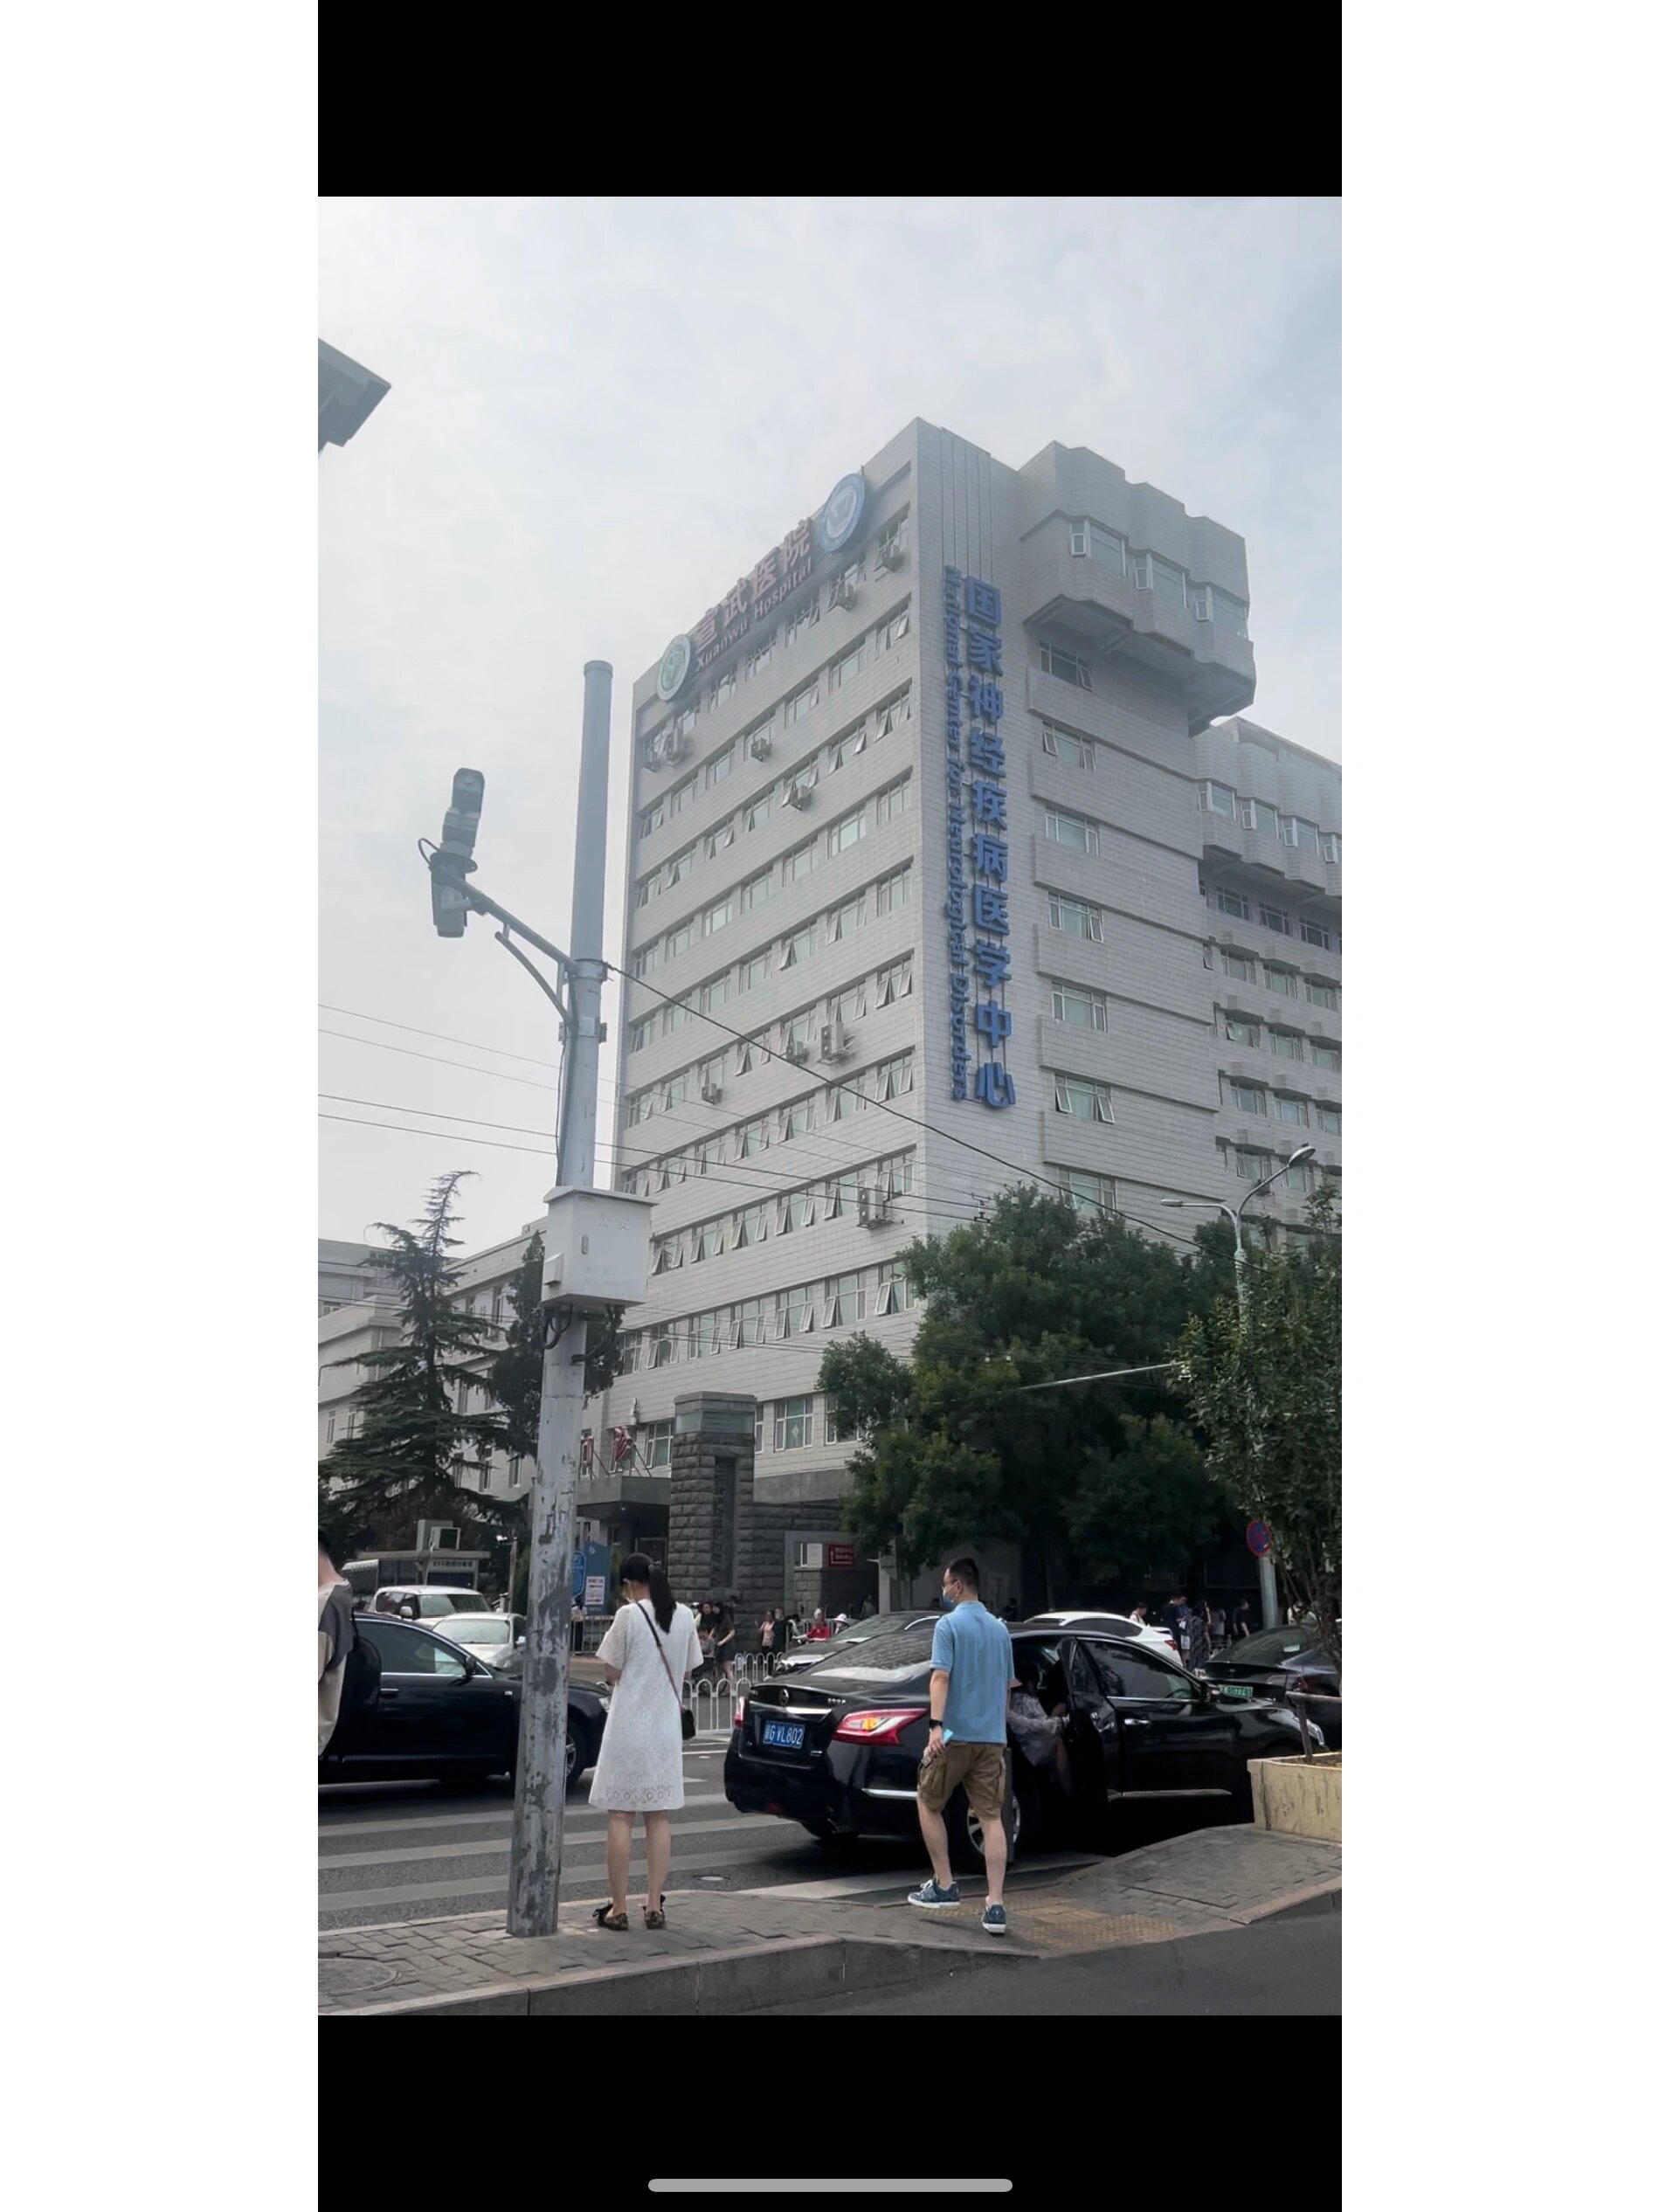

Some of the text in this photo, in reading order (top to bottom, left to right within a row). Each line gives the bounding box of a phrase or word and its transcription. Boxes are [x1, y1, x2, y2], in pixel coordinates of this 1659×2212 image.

[696, 517, 810, 653] 宣武医院
[696, 622, 750, 671] Xuanwu
[754, 556, 812, 618] Hospital
[944, 564, 971, 1101] National Center for Neurological Disorders
[965, 575, 1016, 1109] 国家神经疾病医学中心
